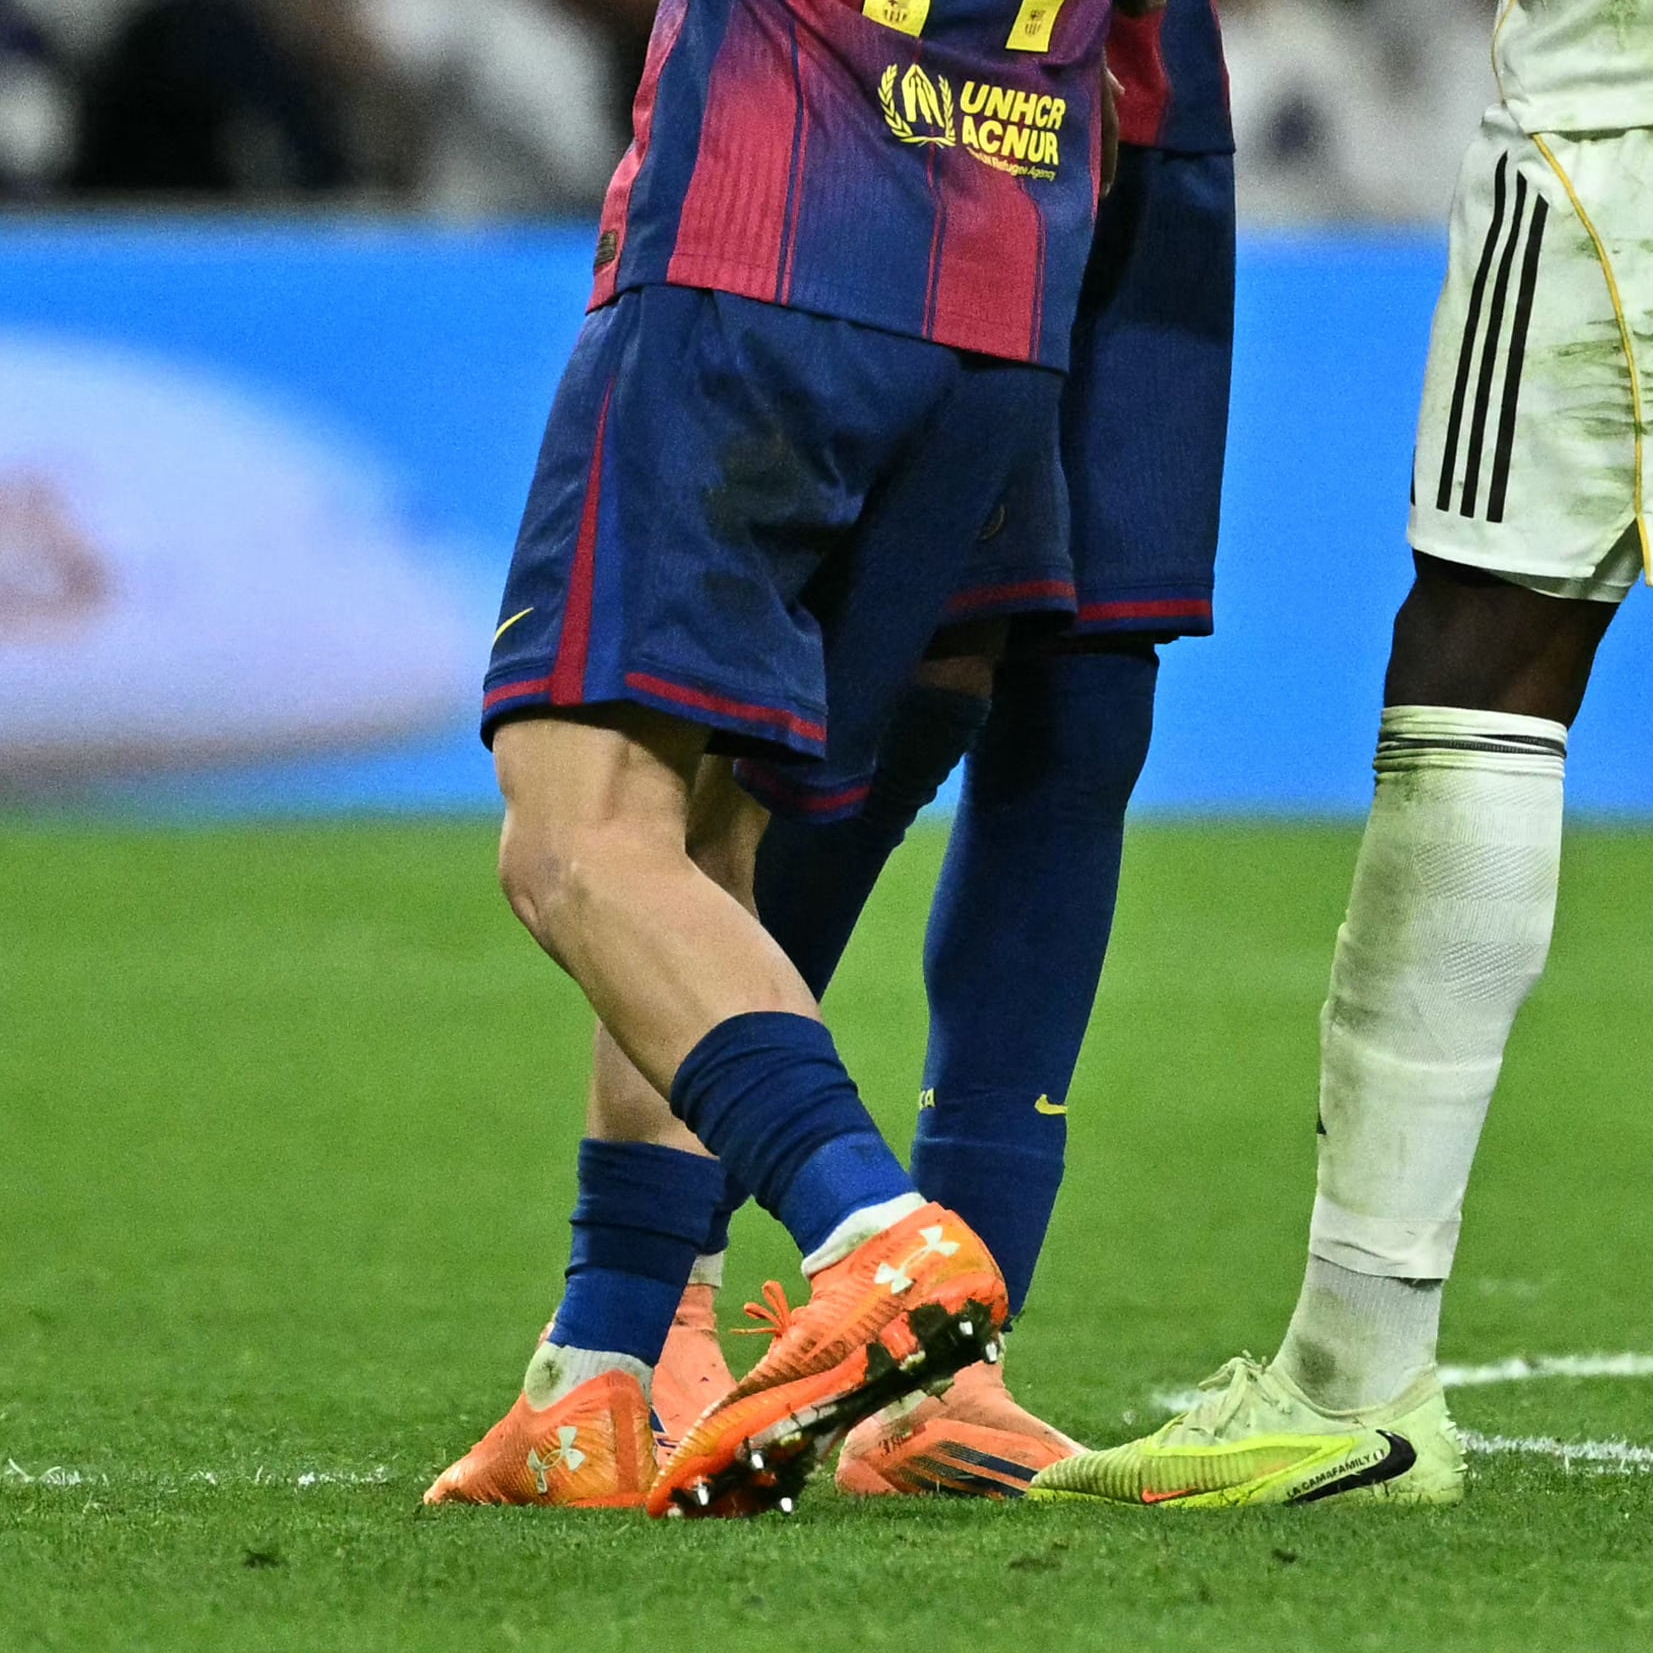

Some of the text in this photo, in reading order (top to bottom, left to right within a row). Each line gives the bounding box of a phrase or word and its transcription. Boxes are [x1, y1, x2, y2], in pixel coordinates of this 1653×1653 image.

[960, 81, 1067, 130] UNHCR
[962, 115, 1060, 166] ACNUR
[1286, 1454, 1371, 1498] LA CAMAFAMILY
